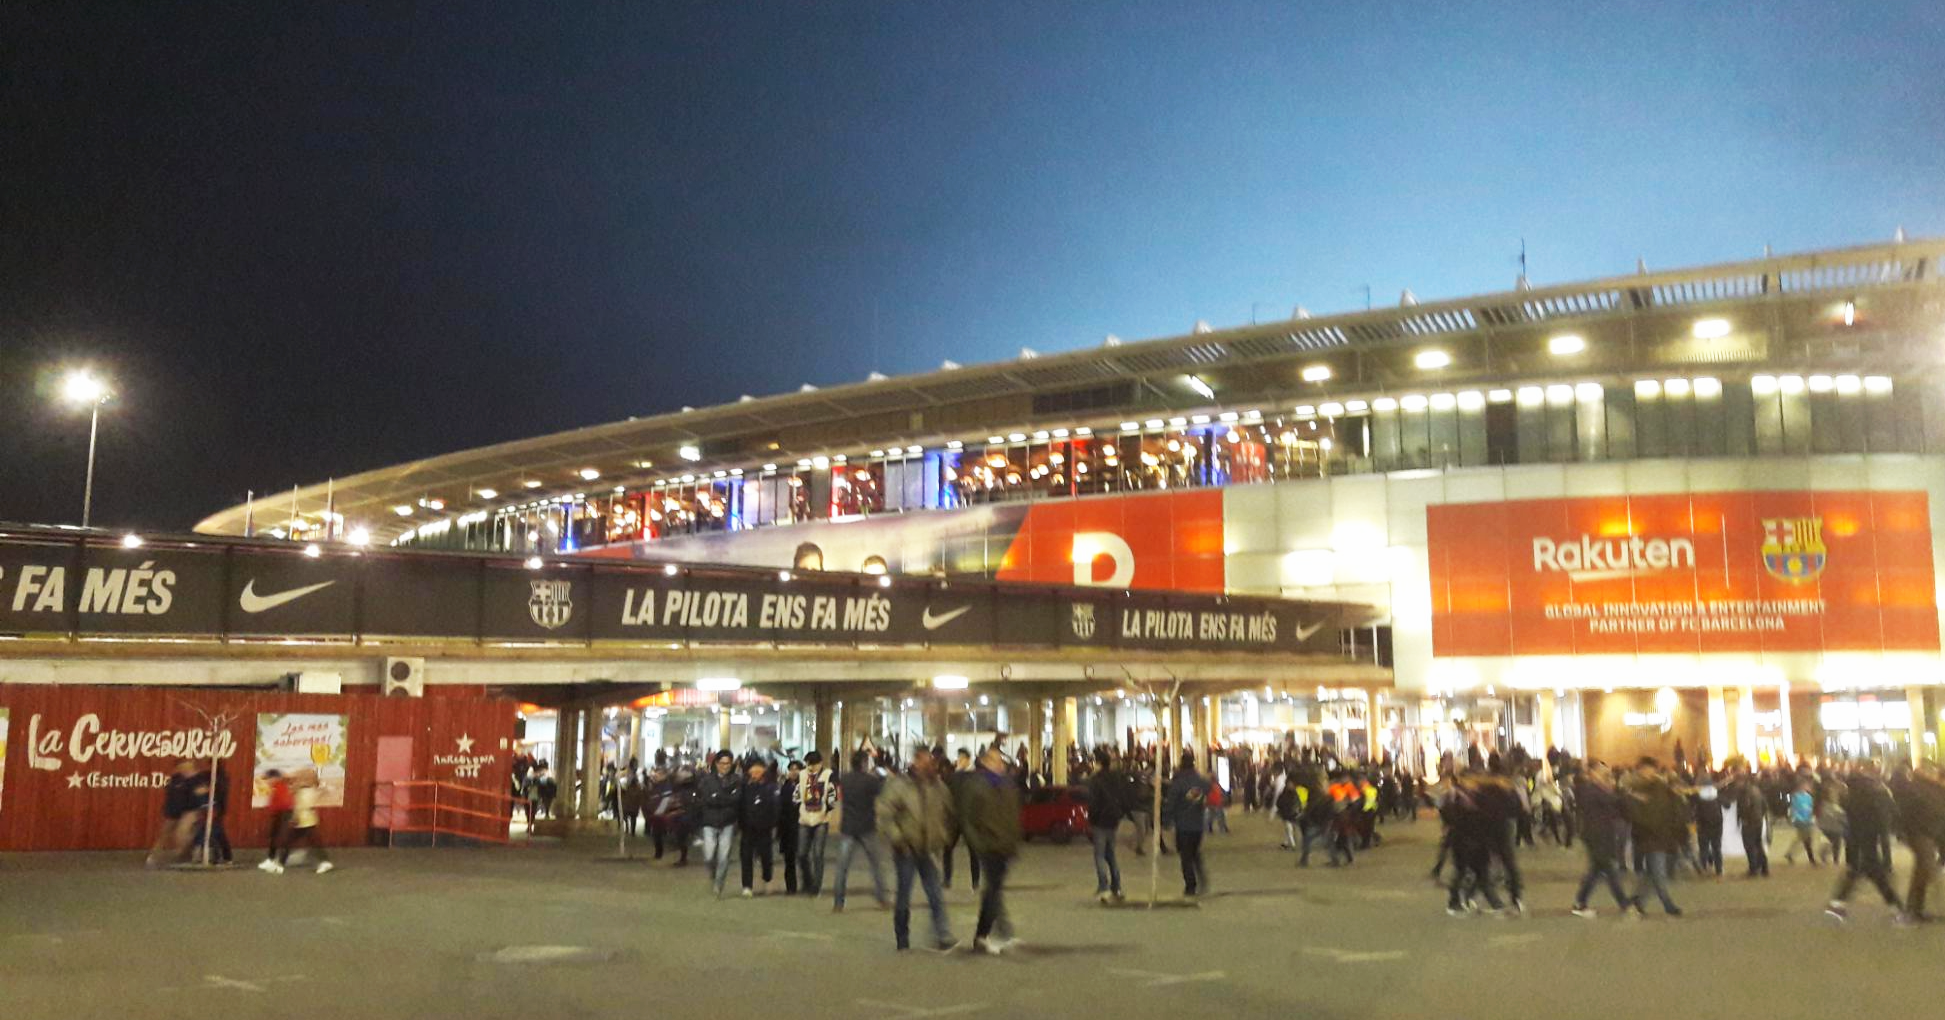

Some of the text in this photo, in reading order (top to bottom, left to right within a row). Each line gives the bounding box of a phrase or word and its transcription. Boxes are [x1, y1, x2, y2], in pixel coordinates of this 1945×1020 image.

[1533, 533, 1695, 573] Rakuten
[12, 560, 176, 615] FA MÉS
[622, 589, 891, 631] LA PILOTA ENS FA MÉS
[1122, 609, 1277, 643] LA PILOTA ENS FA MÉS
[1545, 602, 1599, 620] GLOBAL
[1603, 601, 1693, 618] INNOVATION
[1709, 600, 1825, 616] ENTERTAINMENT
[1589, 617, 1656, 633] PARTNER
[1659, 617, 1677, 633] OF
[1701, 616, 1785, 633] BARCELONA
[28, 713, 63, 771] La
[87, 771, 148, 788] Estrella
